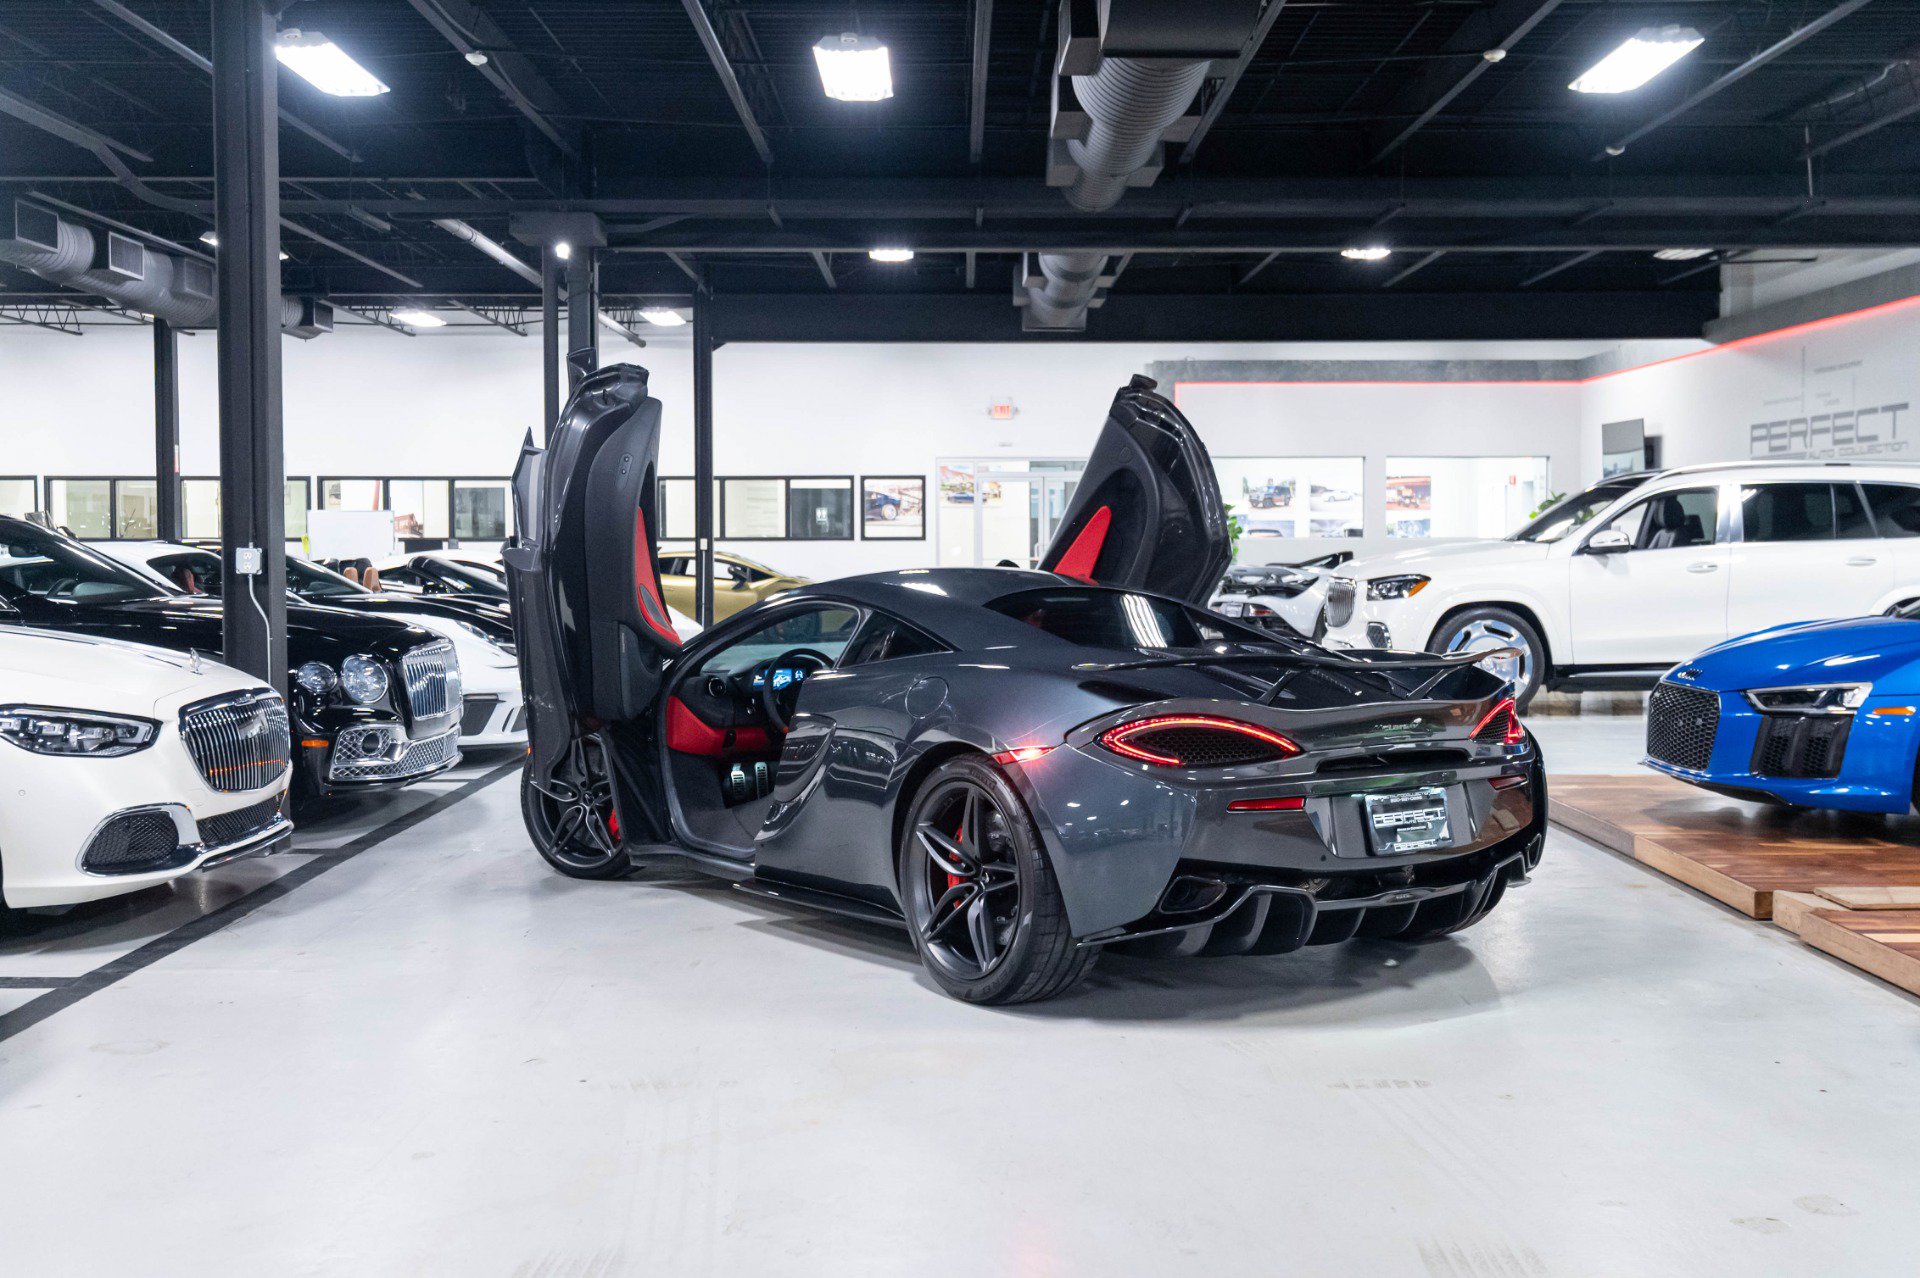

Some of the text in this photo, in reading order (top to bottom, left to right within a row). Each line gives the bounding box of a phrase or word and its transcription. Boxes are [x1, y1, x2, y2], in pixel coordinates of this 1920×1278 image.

[1750, 402, 1909, 455] PERFECT
[1808, 441, 1909, 460] AUTO COLLECTION
[1373, 807, 1445, 825] PERFECT
